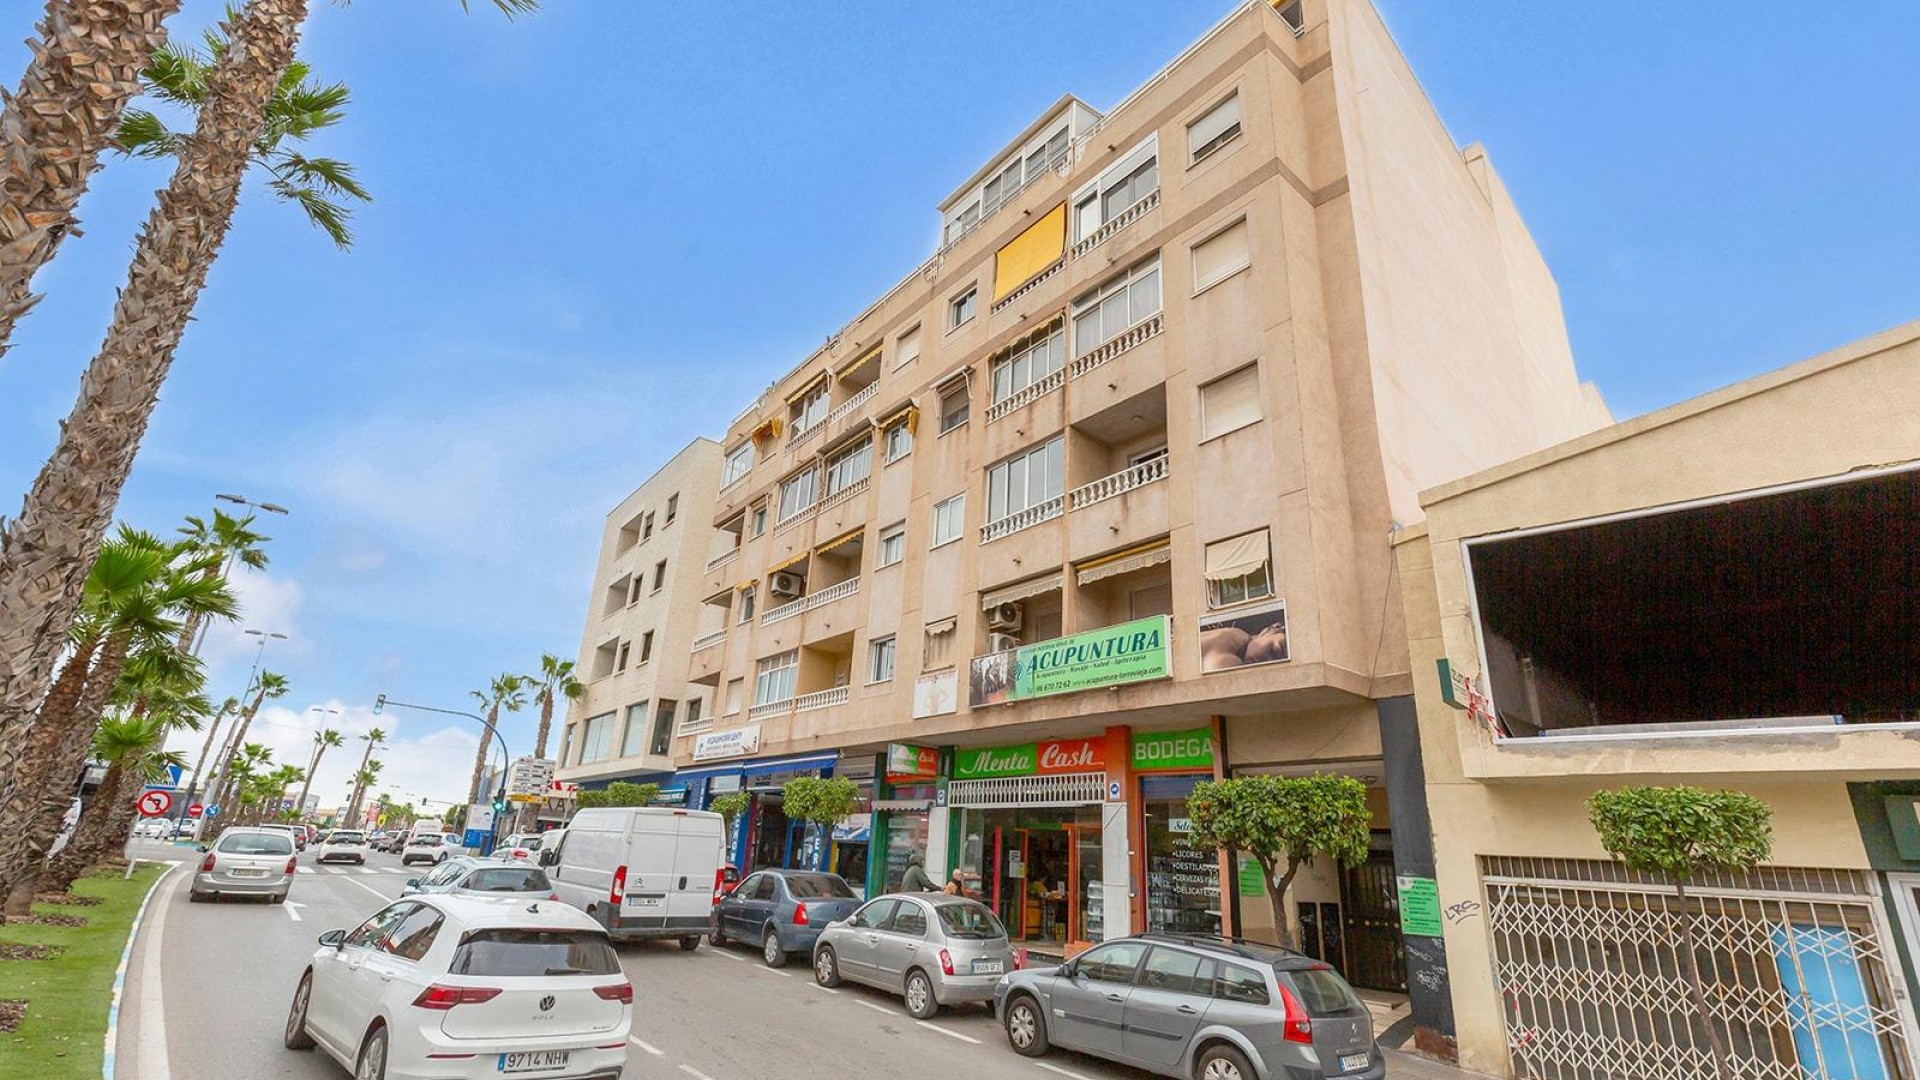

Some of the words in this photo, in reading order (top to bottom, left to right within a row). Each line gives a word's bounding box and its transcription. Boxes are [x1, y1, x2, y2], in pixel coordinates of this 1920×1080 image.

[1027, 629, 1160, 675] ACUPUNTURA
[960, 751, 1031, 774] Menta
[1040, 743, 1105, 769] Cash
[1135, 739, 1214, 761] BODEGA
[1175, 850, 1203, 859] LICORES
[1175, 874, 1204, 883] CERVEZAS
[508, 1053, 541, 1068] 9714
[545, 1051, 570, 1065] NHW
